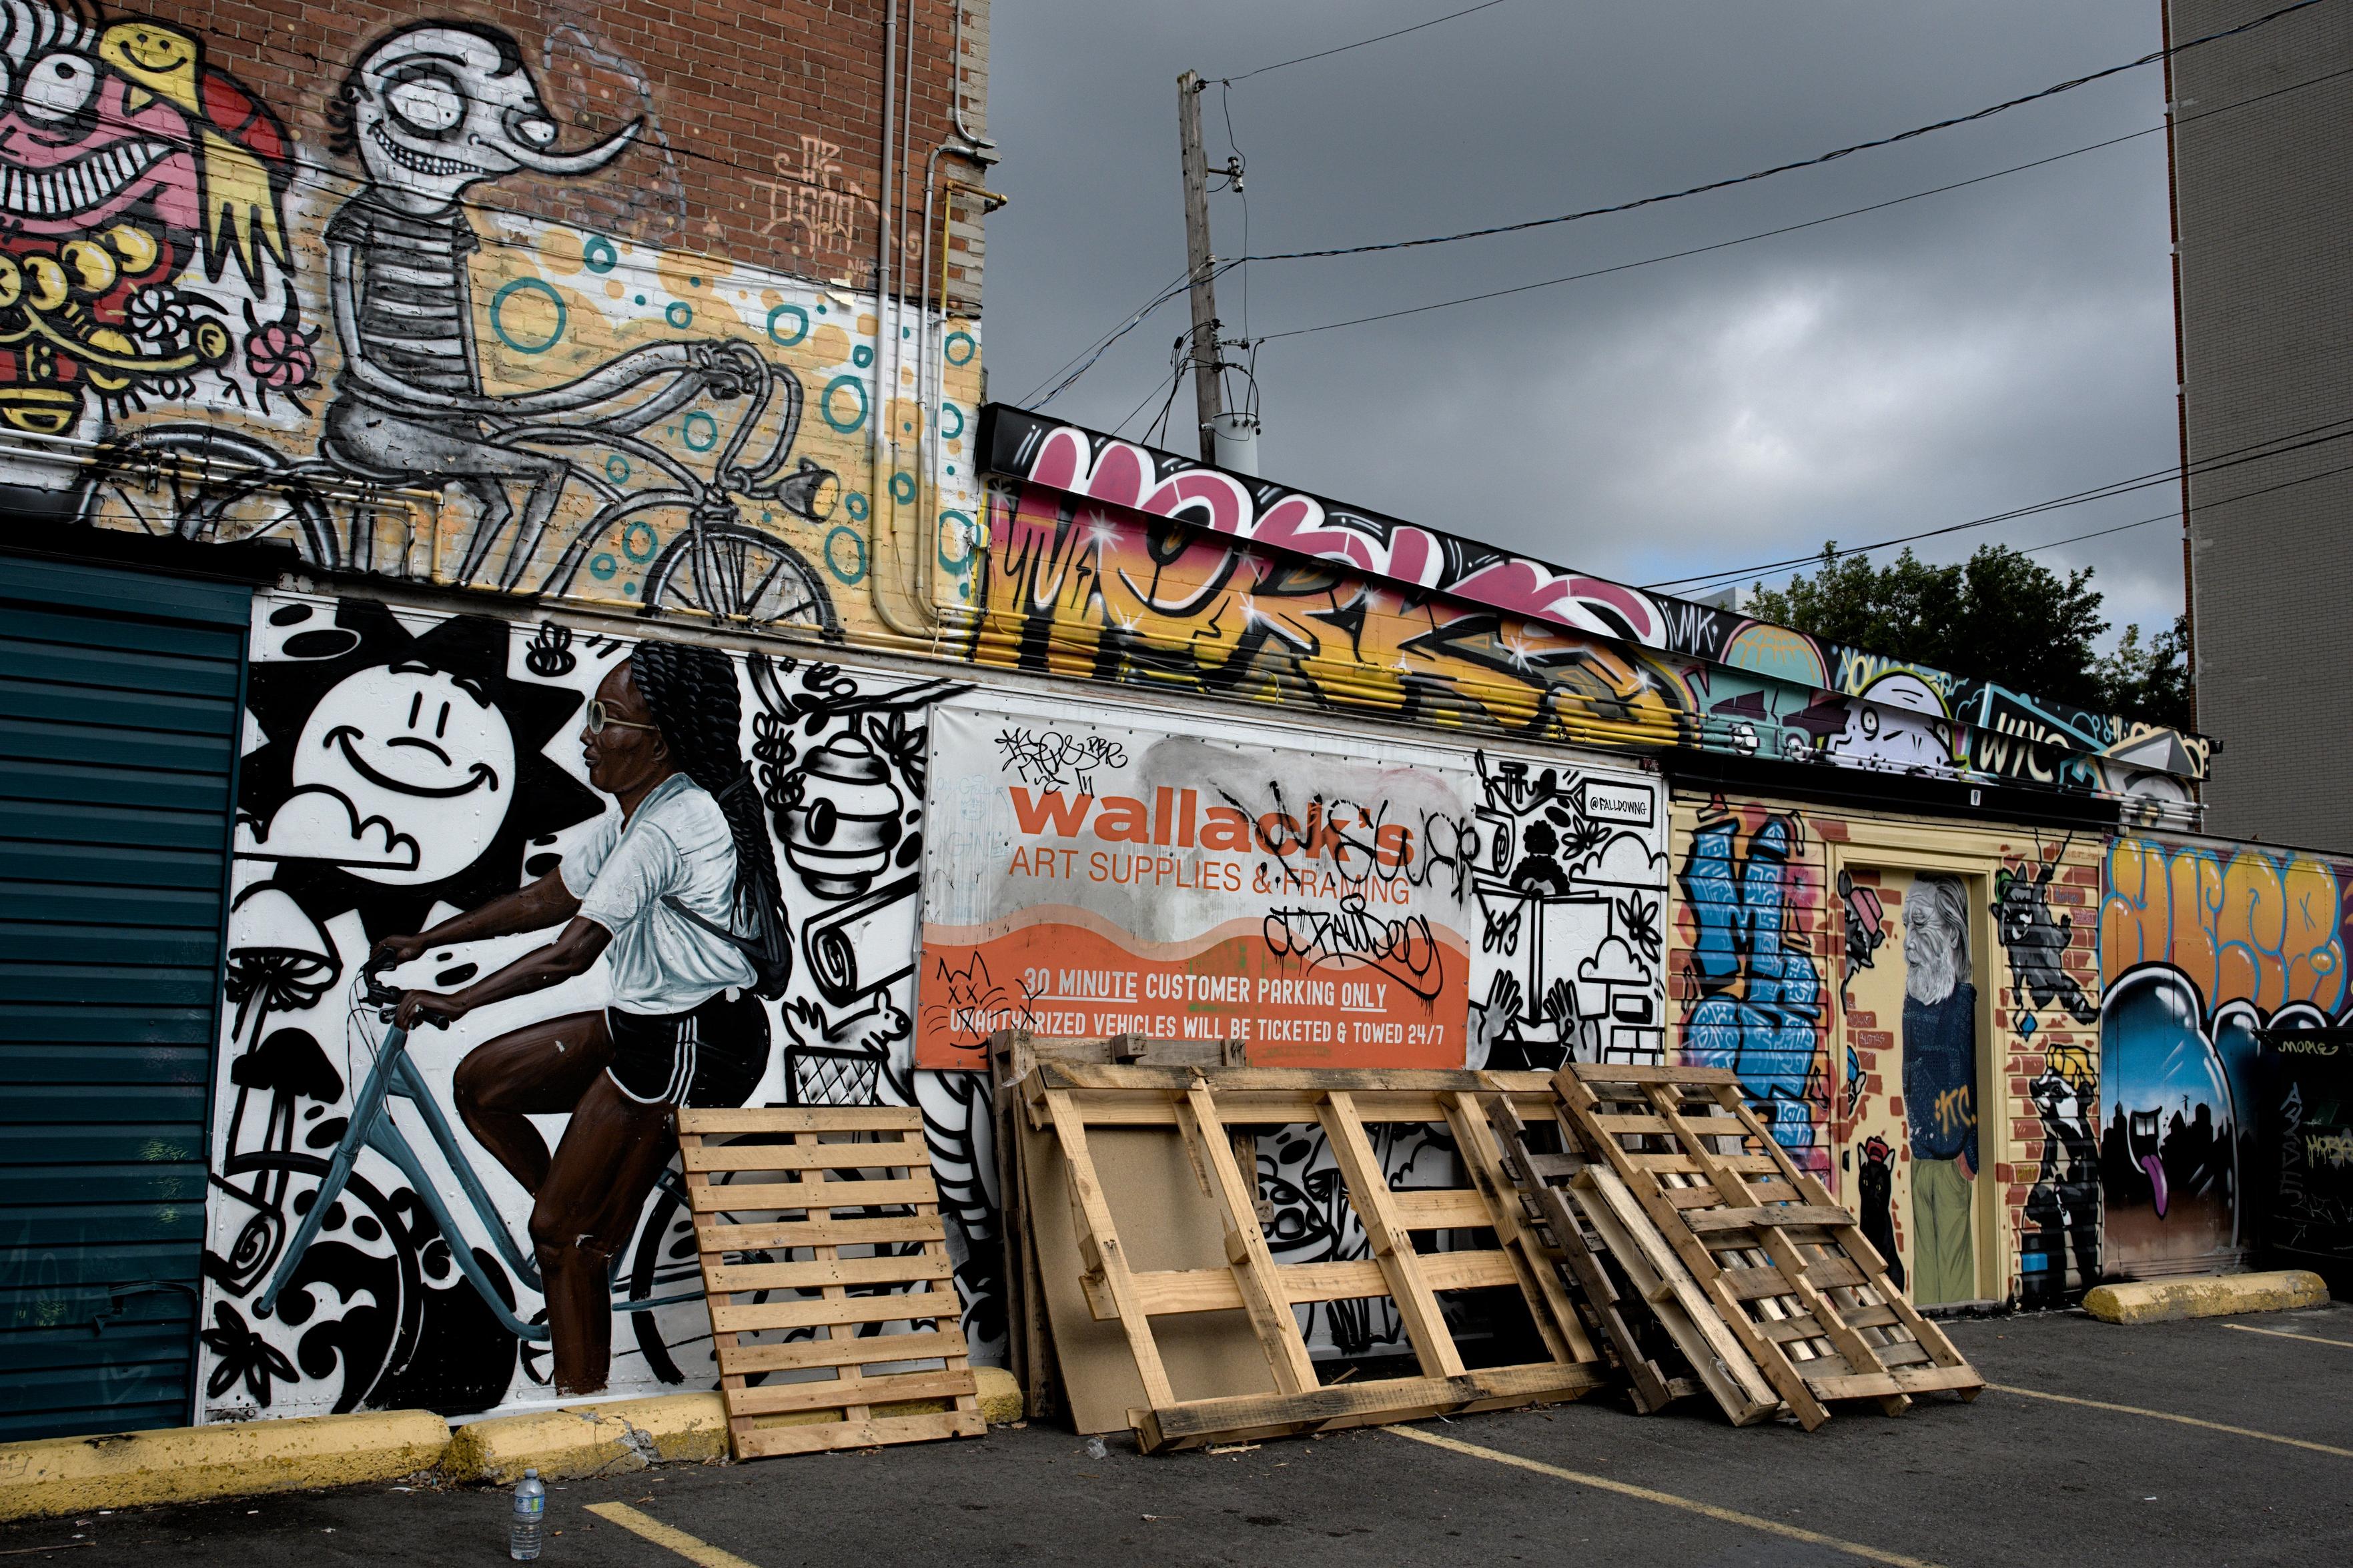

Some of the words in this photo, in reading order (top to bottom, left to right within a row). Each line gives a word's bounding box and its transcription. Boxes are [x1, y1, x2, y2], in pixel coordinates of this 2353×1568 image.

[1590, 796, 1647, 815] @FALLDOWNG
[1009, 786, 1414, 867] wallack's
[1008, 846, 1079, 879] ART
[1088, 851, 1242, 892] SUPPLIES
[1252, 862, 1273, 894] &
[1283, 868, 1410, 905] FRAMING
[1025, 967, 1050, 995] 30
[1058, 968, 1138, 999] MINUTE
[1145, 973, 1250, 1003] CUSTOMER
[1258, 978, 1334, 1006] PARKING
[1341, 982, 1387, 1008] ONLY
[949, 1008, 1087, 1036] UNAUTHORIZED
[1093, 1013, 1177, 1038] VEHICLES
[1183, 1016, 1224, 1039] WILL
[1230, 1018, 1251, 1040] BE
[1257, 1018, 1332, 1042] TICKETED
[1337, 1022, 1346, 1044] &
[1352, 1022, 1402, 1045] TOWED
[1408, 1024, 1444, 1046] 24/7
